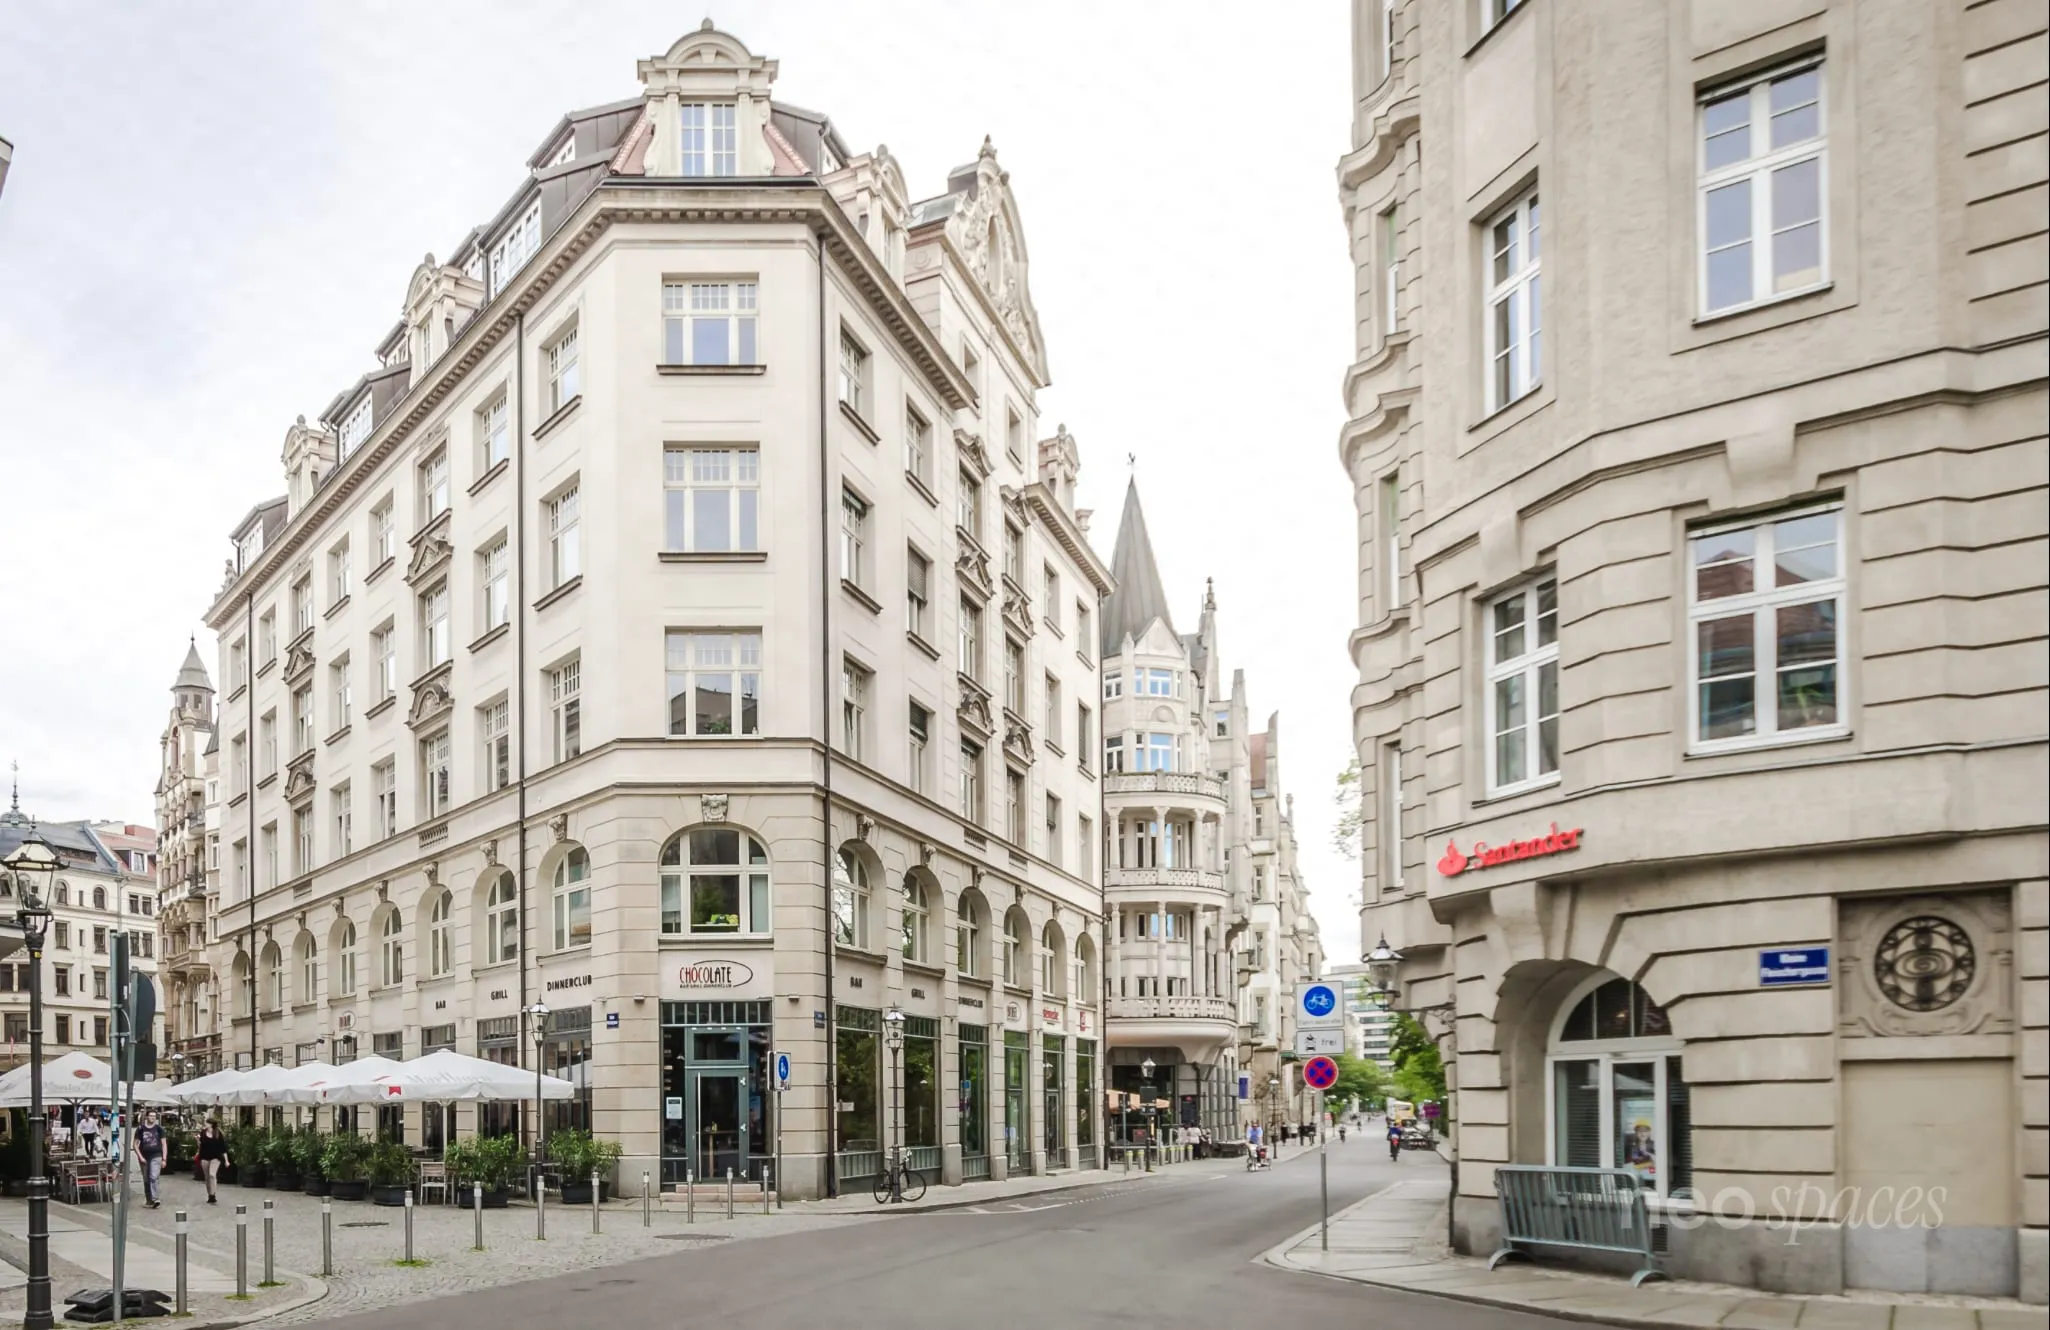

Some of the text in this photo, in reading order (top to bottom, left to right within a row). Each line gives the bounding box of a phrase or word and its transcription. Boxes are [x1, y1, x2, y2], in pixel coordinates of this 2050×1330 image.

[1474, 821, 1584, 869] Santander
[680, 966, 732, 984] CHOCOLATE
[547, 974, 593, 991] DINNERCLUB
[490, 989, 508, 1001] GRILL
[435, 1000, 447, 1010] BAR
[1321, 1038, 1337, 1046] frei
